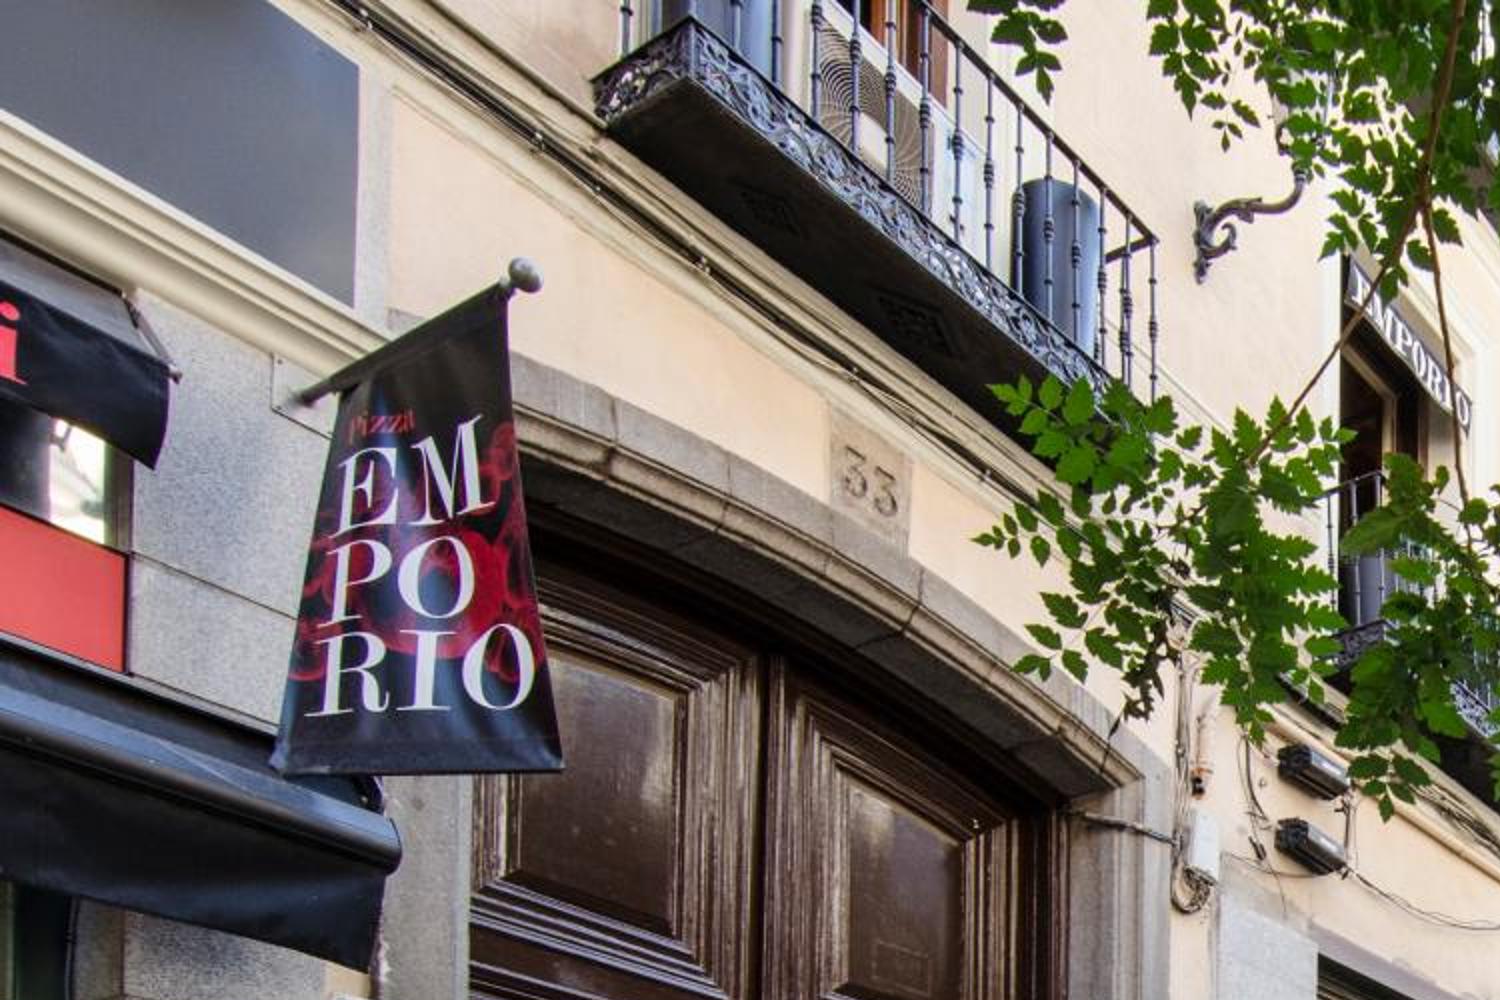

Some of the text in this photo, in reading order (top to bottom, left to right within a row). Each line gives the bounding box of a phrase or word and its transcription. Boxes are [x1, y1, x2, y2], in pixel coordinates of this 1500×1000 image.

[333, 413, 496, 538] EM
[841, 444, 899, 518] 33
[317, 535, 475, 628] PO
[304, 623, 536, 717] RIO
